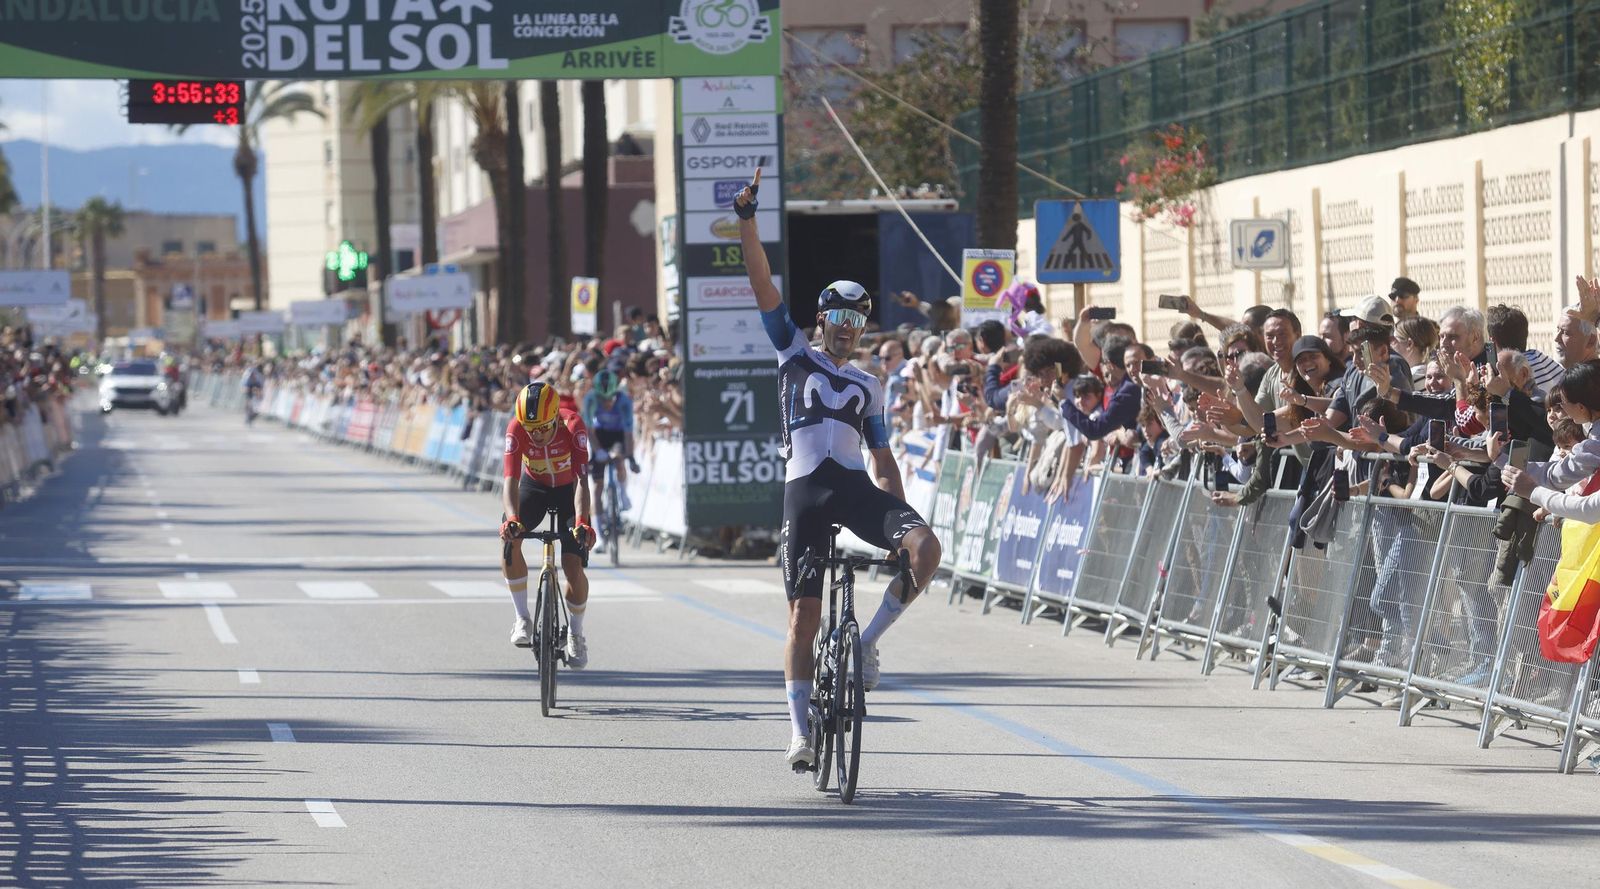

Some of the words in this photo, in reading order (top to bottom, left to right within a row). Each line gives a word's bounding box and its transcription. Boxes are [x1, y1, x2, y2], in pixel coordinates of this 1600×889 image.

[513, 13, 531, 25] LA
[535, 13, 576, 25] LINEA
[579, 13, 597, 25] DE
[600, 13, 619, 25] LA
[241, 0, 265, 69] 2025
[562, 46, 656, 68] ARRIVÈE
[153, 83, 239, 104] 3:55:33
[213, 108, 238, 126] +3
[687, 156, 758, 169] GSPORT
[721, 391, 755, 422] 71
[687, 441, 759, 462] RUTA
[783, 541, 791, 581] Telefónica
